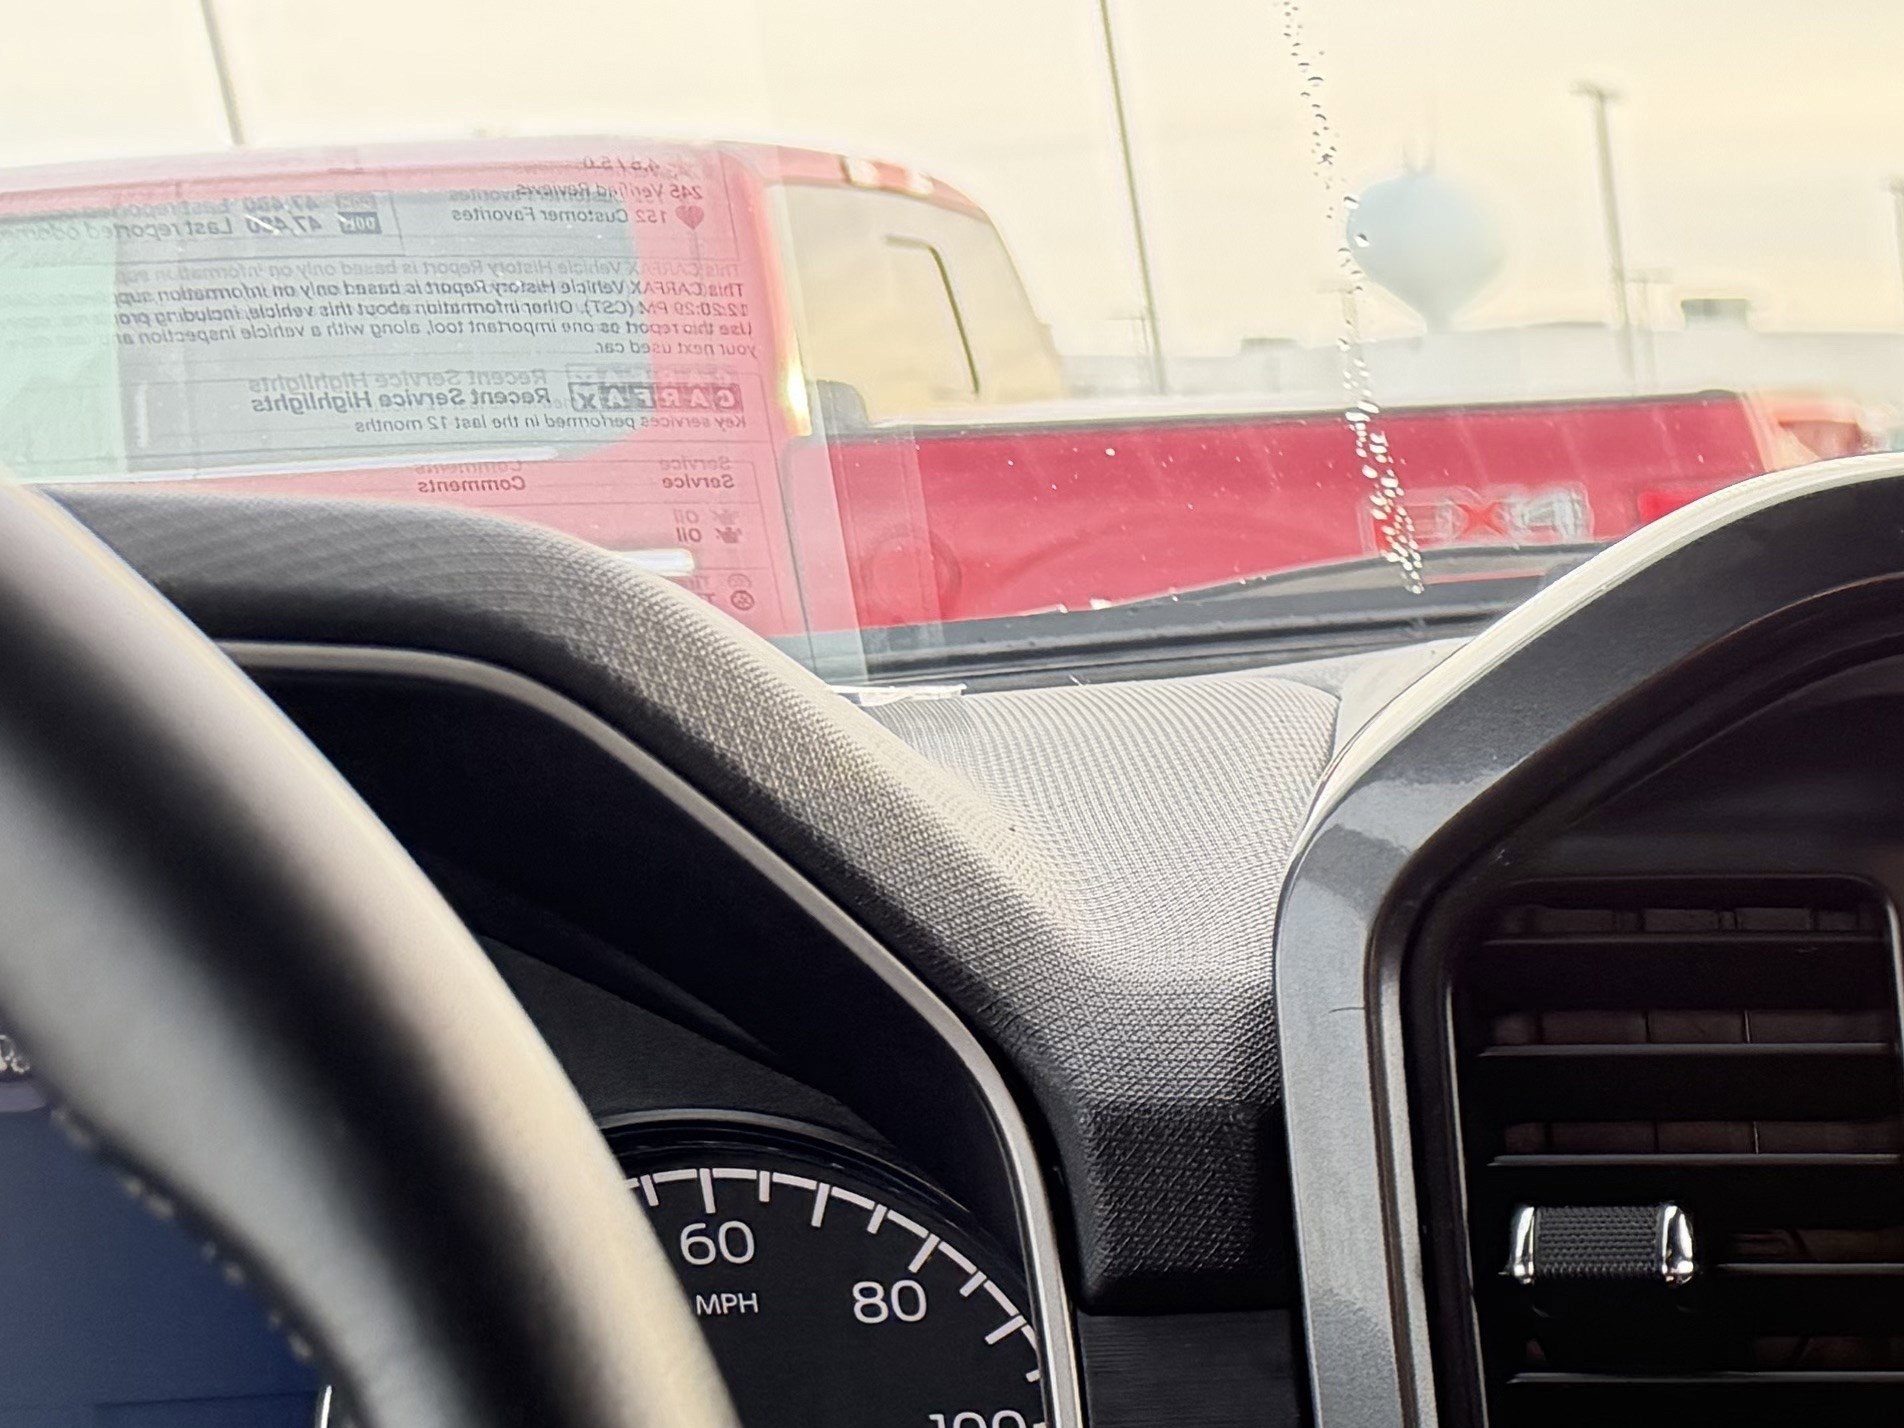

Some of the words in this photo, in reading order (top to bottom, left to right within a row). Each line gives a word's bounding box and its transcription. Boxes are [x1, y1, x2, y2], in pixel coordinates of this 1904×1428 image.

[679, 1220, 756, 1266] 60
[695, 1292, 759, 1317] MPH
[852, 1280, 928, 1324] 80
